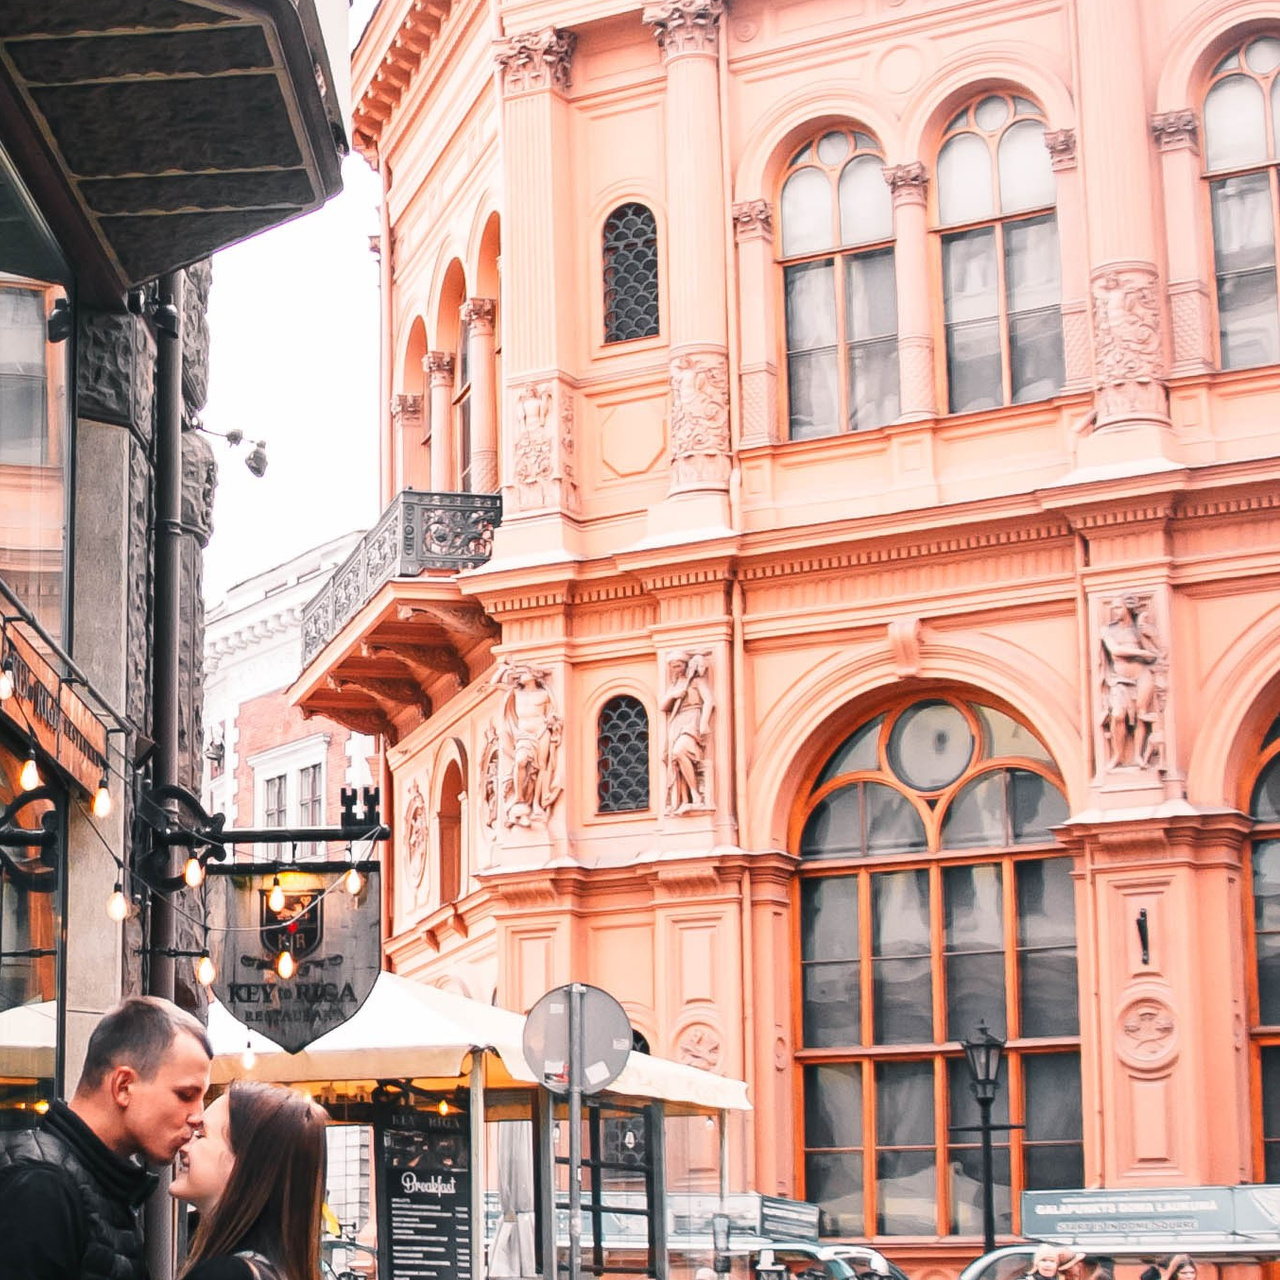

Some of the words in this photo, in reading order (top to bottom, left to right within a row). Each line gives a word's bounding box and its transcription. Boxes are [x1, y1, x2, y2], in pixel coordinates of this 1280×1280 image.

[228, 982, 277, 1003] KEY
[295, 981, 358, 1003] RIGA
[401, 1171, 457, 1198] Breakfast
